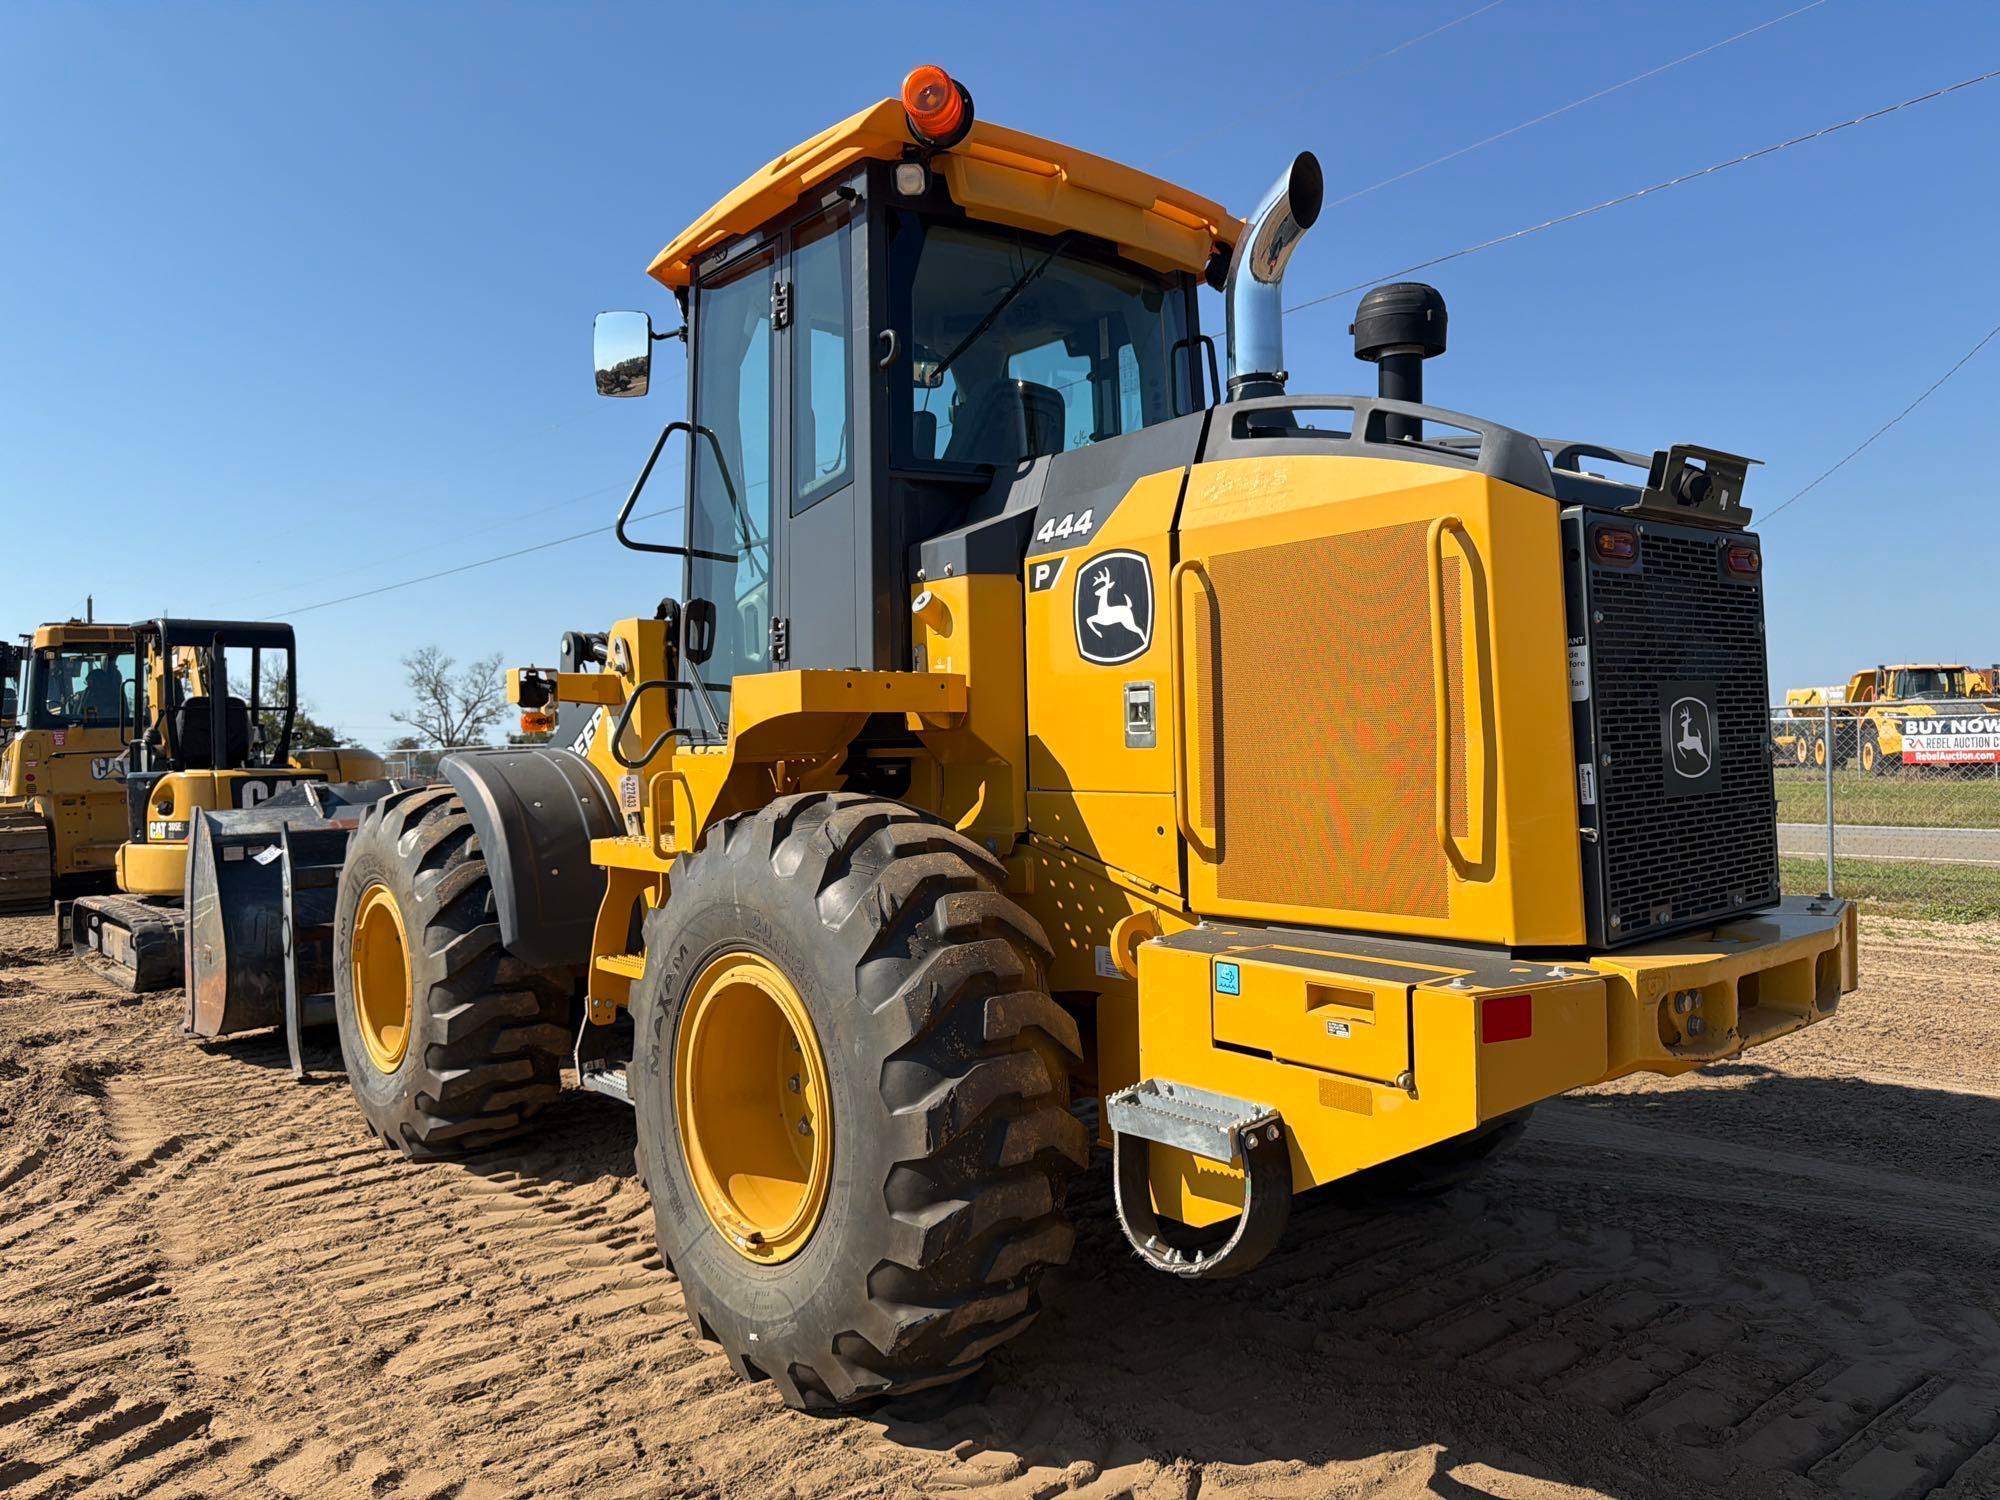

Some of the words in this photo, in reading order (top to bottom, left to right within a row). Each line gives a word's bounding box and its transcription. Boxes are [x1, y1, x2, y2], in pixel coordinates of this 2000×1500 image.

[1037, 509, 1093, 543] 444
[1034, 564, 1051, 589] P
[1905, 720, 1946, 734] BUY
[1951, 718, 2000, 733] NOW
[1926, 737, 1951, 749] REBEL
[1954, 736, 1990, 749] AUCTION
[1915, 751, 1996, 761] RebelAuction.com
[625, 782, 637, 808] 227433
[150, 821, 166, 838] CAT
[651, 944, 688, 1077] MAXAM
